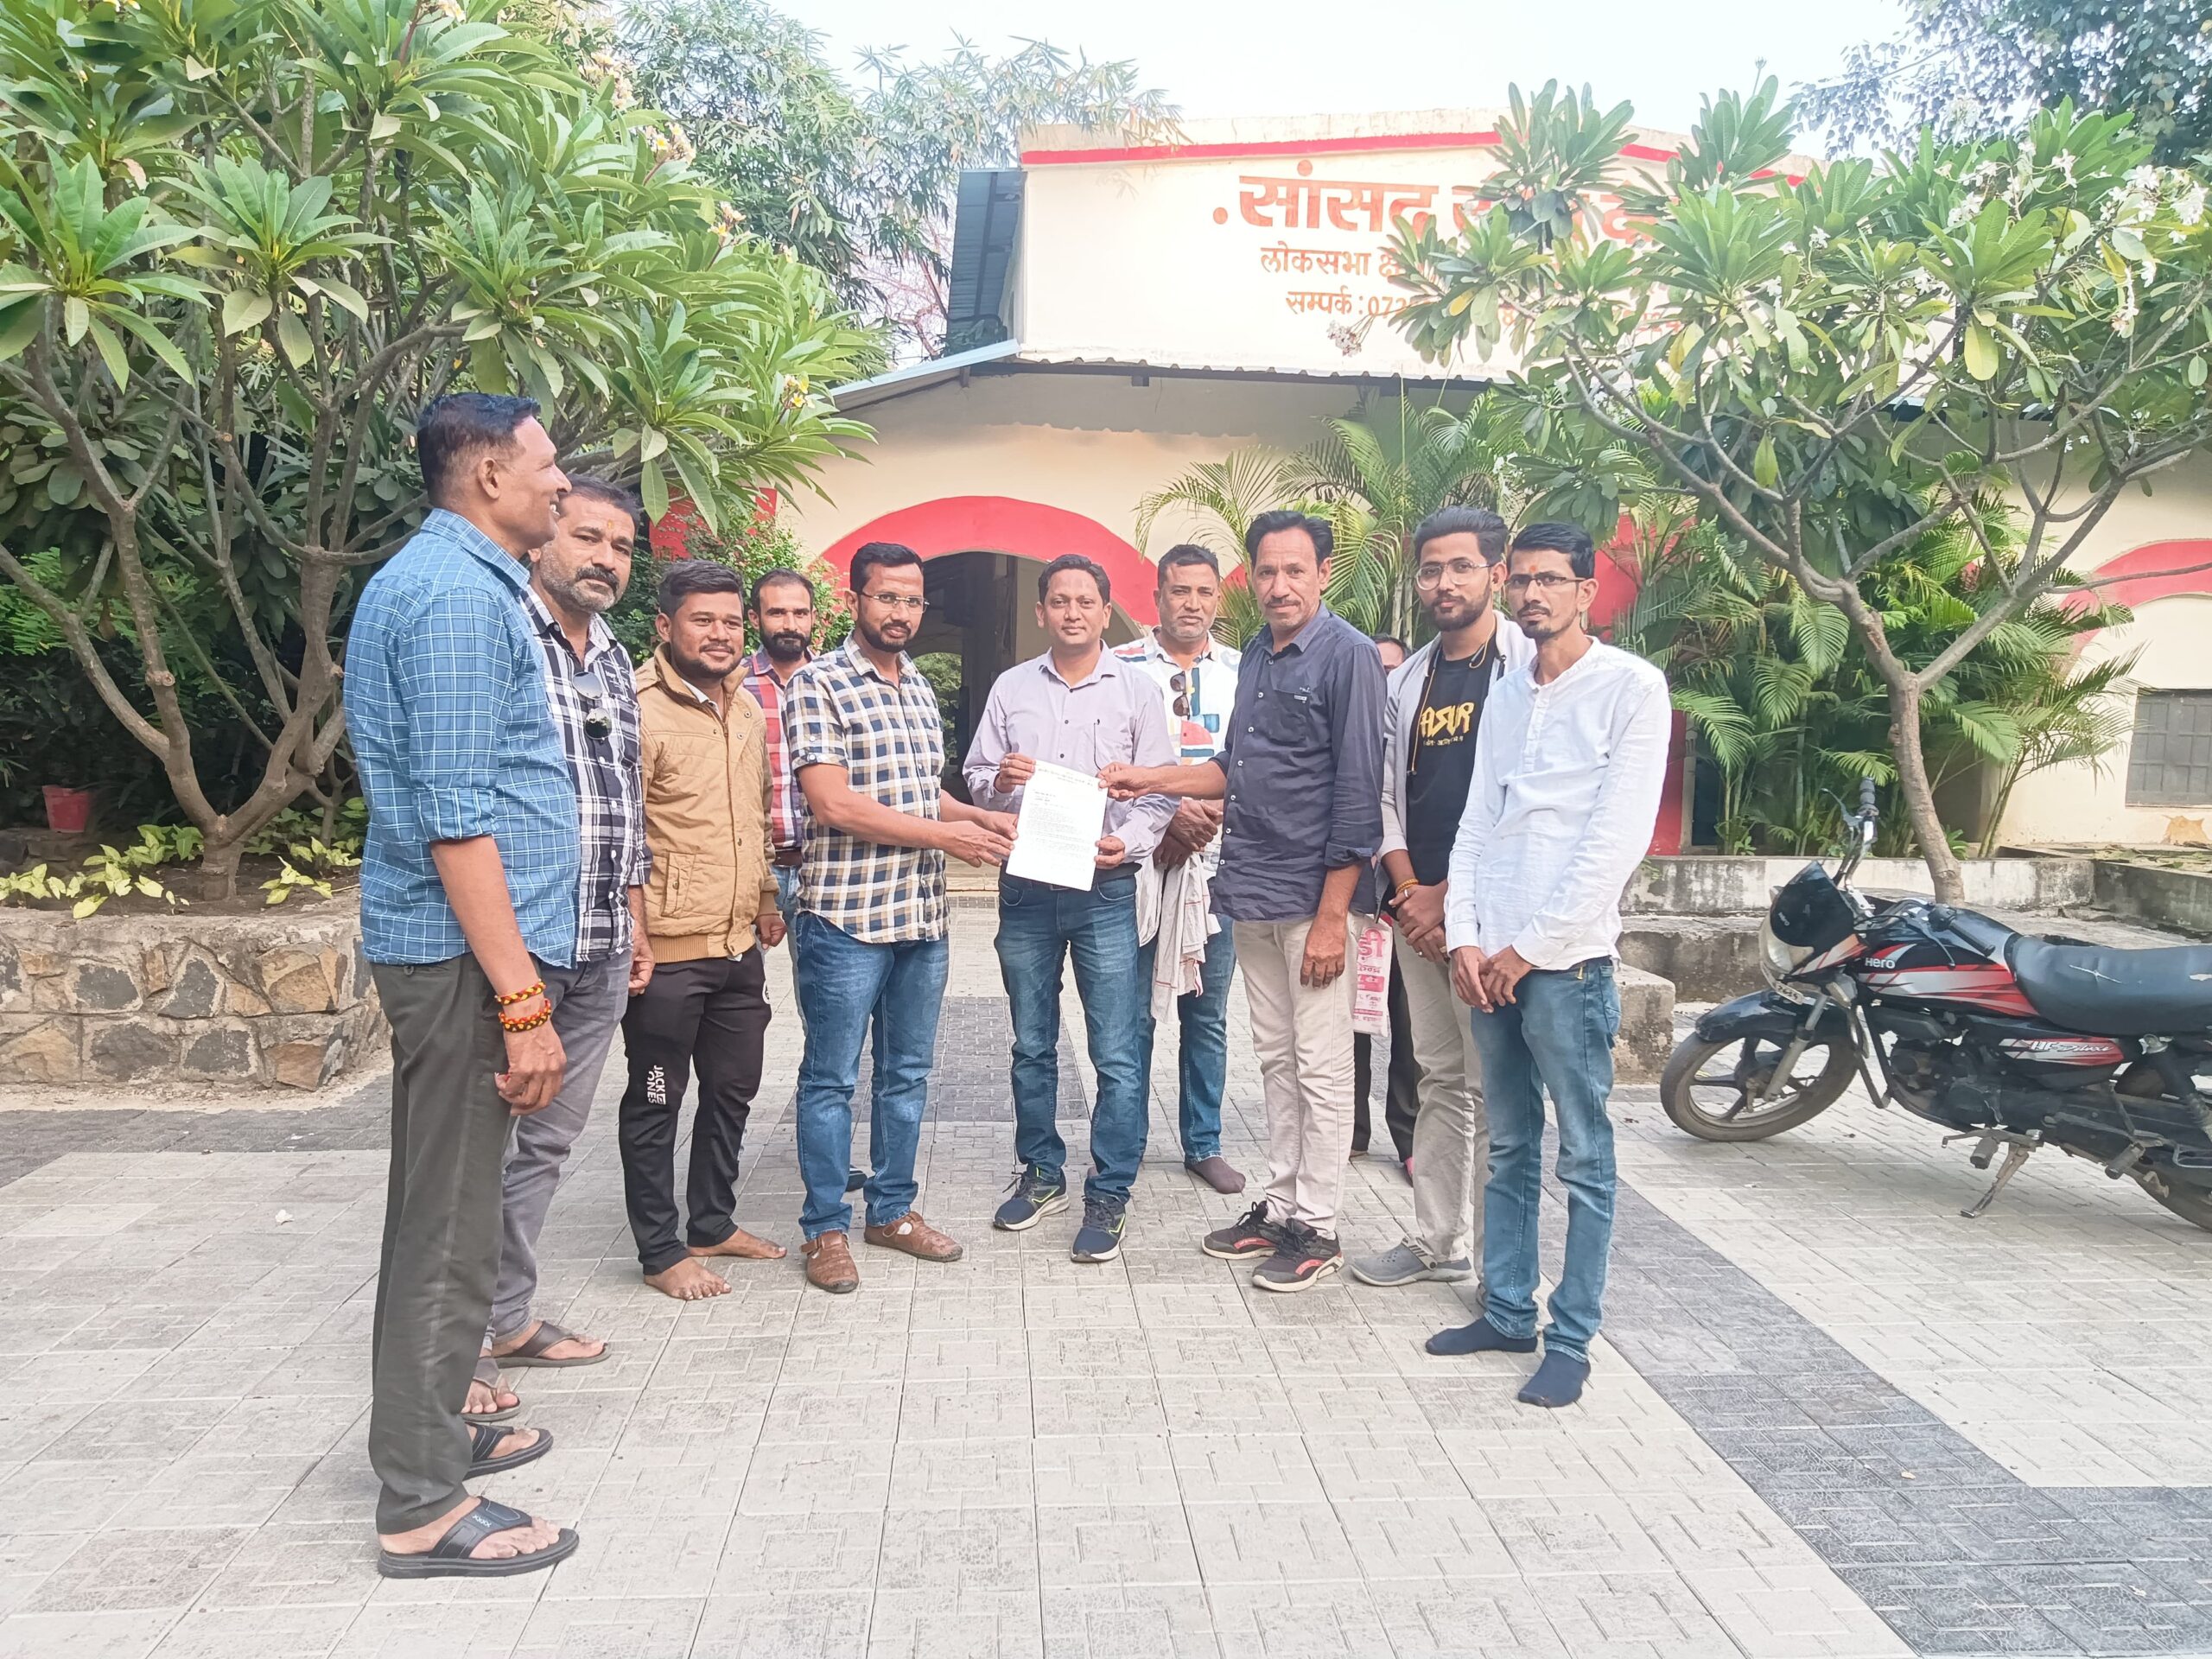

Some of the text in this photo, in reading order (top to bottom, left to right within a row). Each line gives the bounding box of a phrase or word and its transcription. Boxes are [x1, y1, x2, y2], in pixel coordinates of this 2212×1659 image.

[1261, 240, 1371, 276] लोकसभा
[2031, 1040, 2058, 1051] HF
[653, 1065, 665, 1092] JACK
